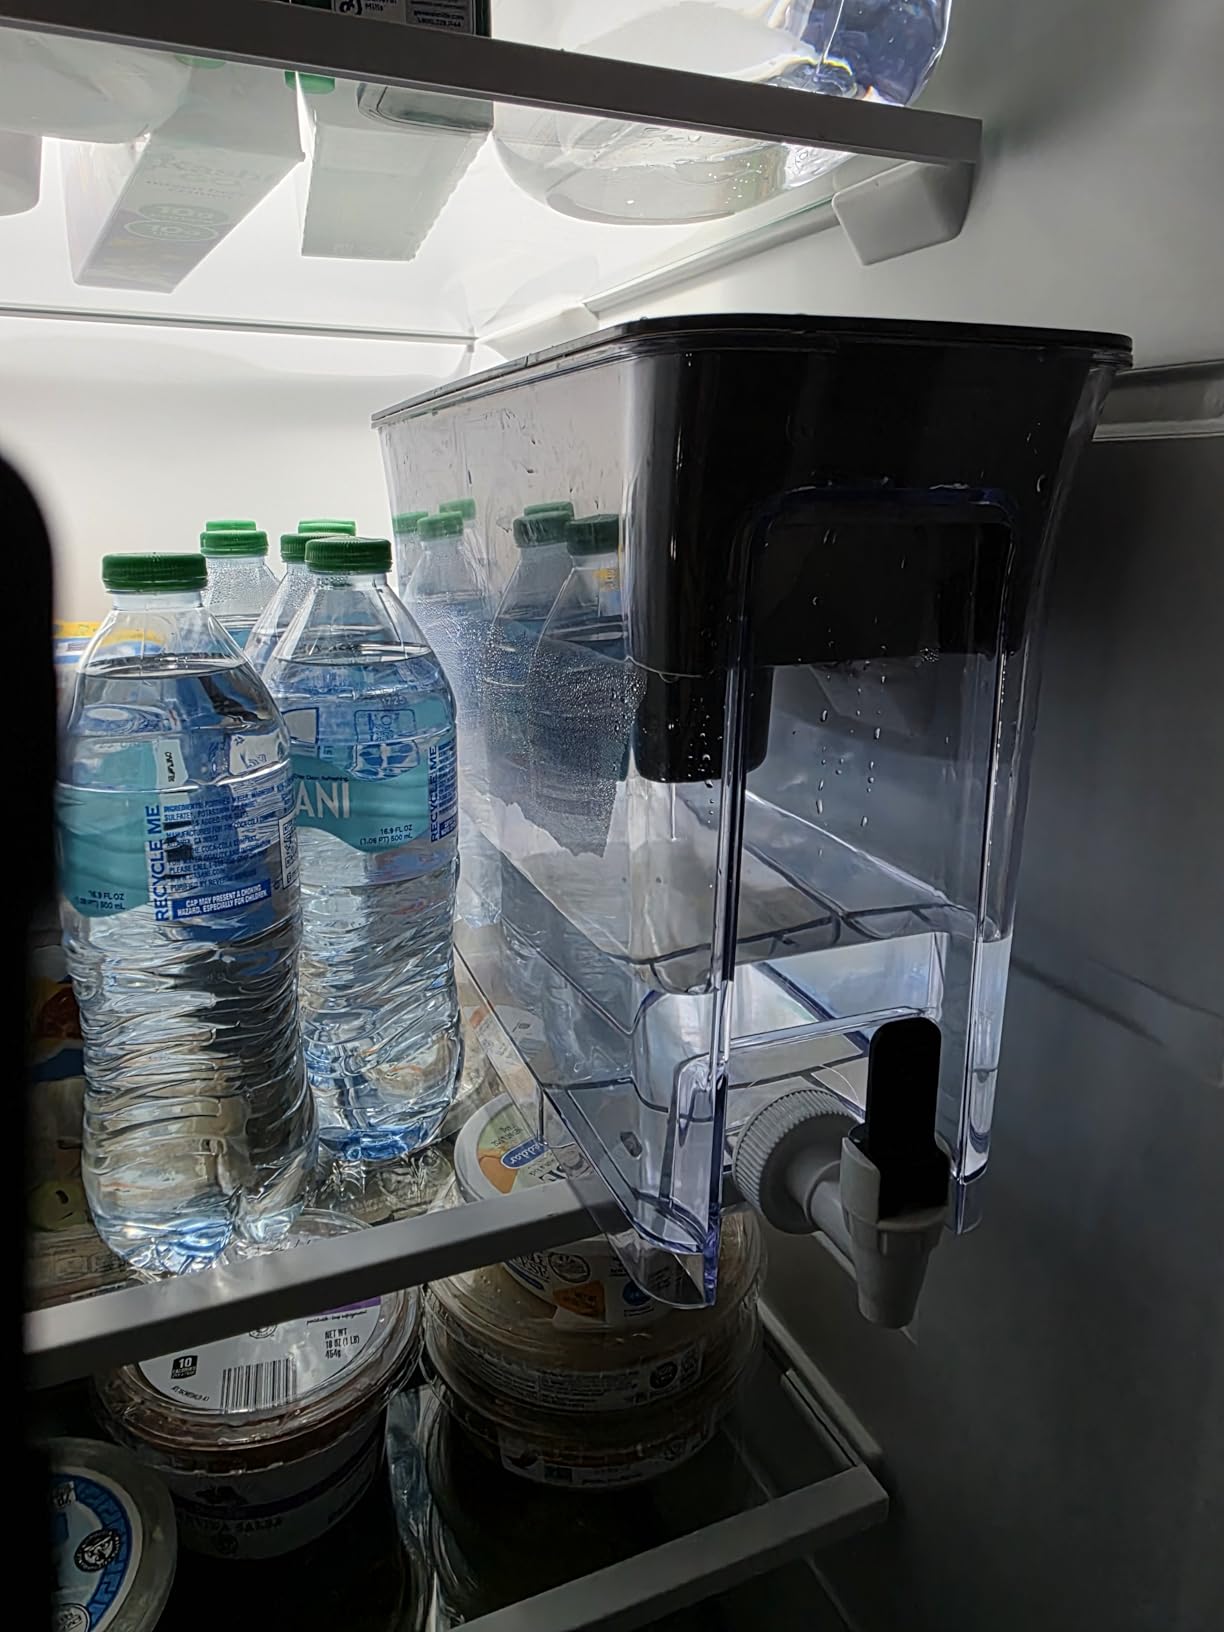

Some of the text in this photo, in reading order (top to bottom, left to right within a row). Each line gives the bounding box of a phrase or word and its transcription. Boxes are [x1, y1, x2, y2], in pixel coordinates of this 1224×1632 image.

[295, 780, 350, 819] ANI
[429, 745, 439, 842] RECYCLE ME
[404, 824, 413, 832] OZ
[391, 834, 403, 842] 500
[403, 832, 413, 840] mL
[145, 804, 170, 921] RECYCLE ME
[113, 892, 125, 901] OZ
[186, 899, 199, 908] CAP
[199, 898, 211, 906] MAY
[212, 892, 236, 904] PRESENT
[240, 884, 262, 895] CHOKING
[203, 901, 233, 913] ESPECIALLY
[234, 897, 245, 906] FOR
[325, 1327, 347, 1341] NET WT
[178, 1357, 192, 1368] 10
